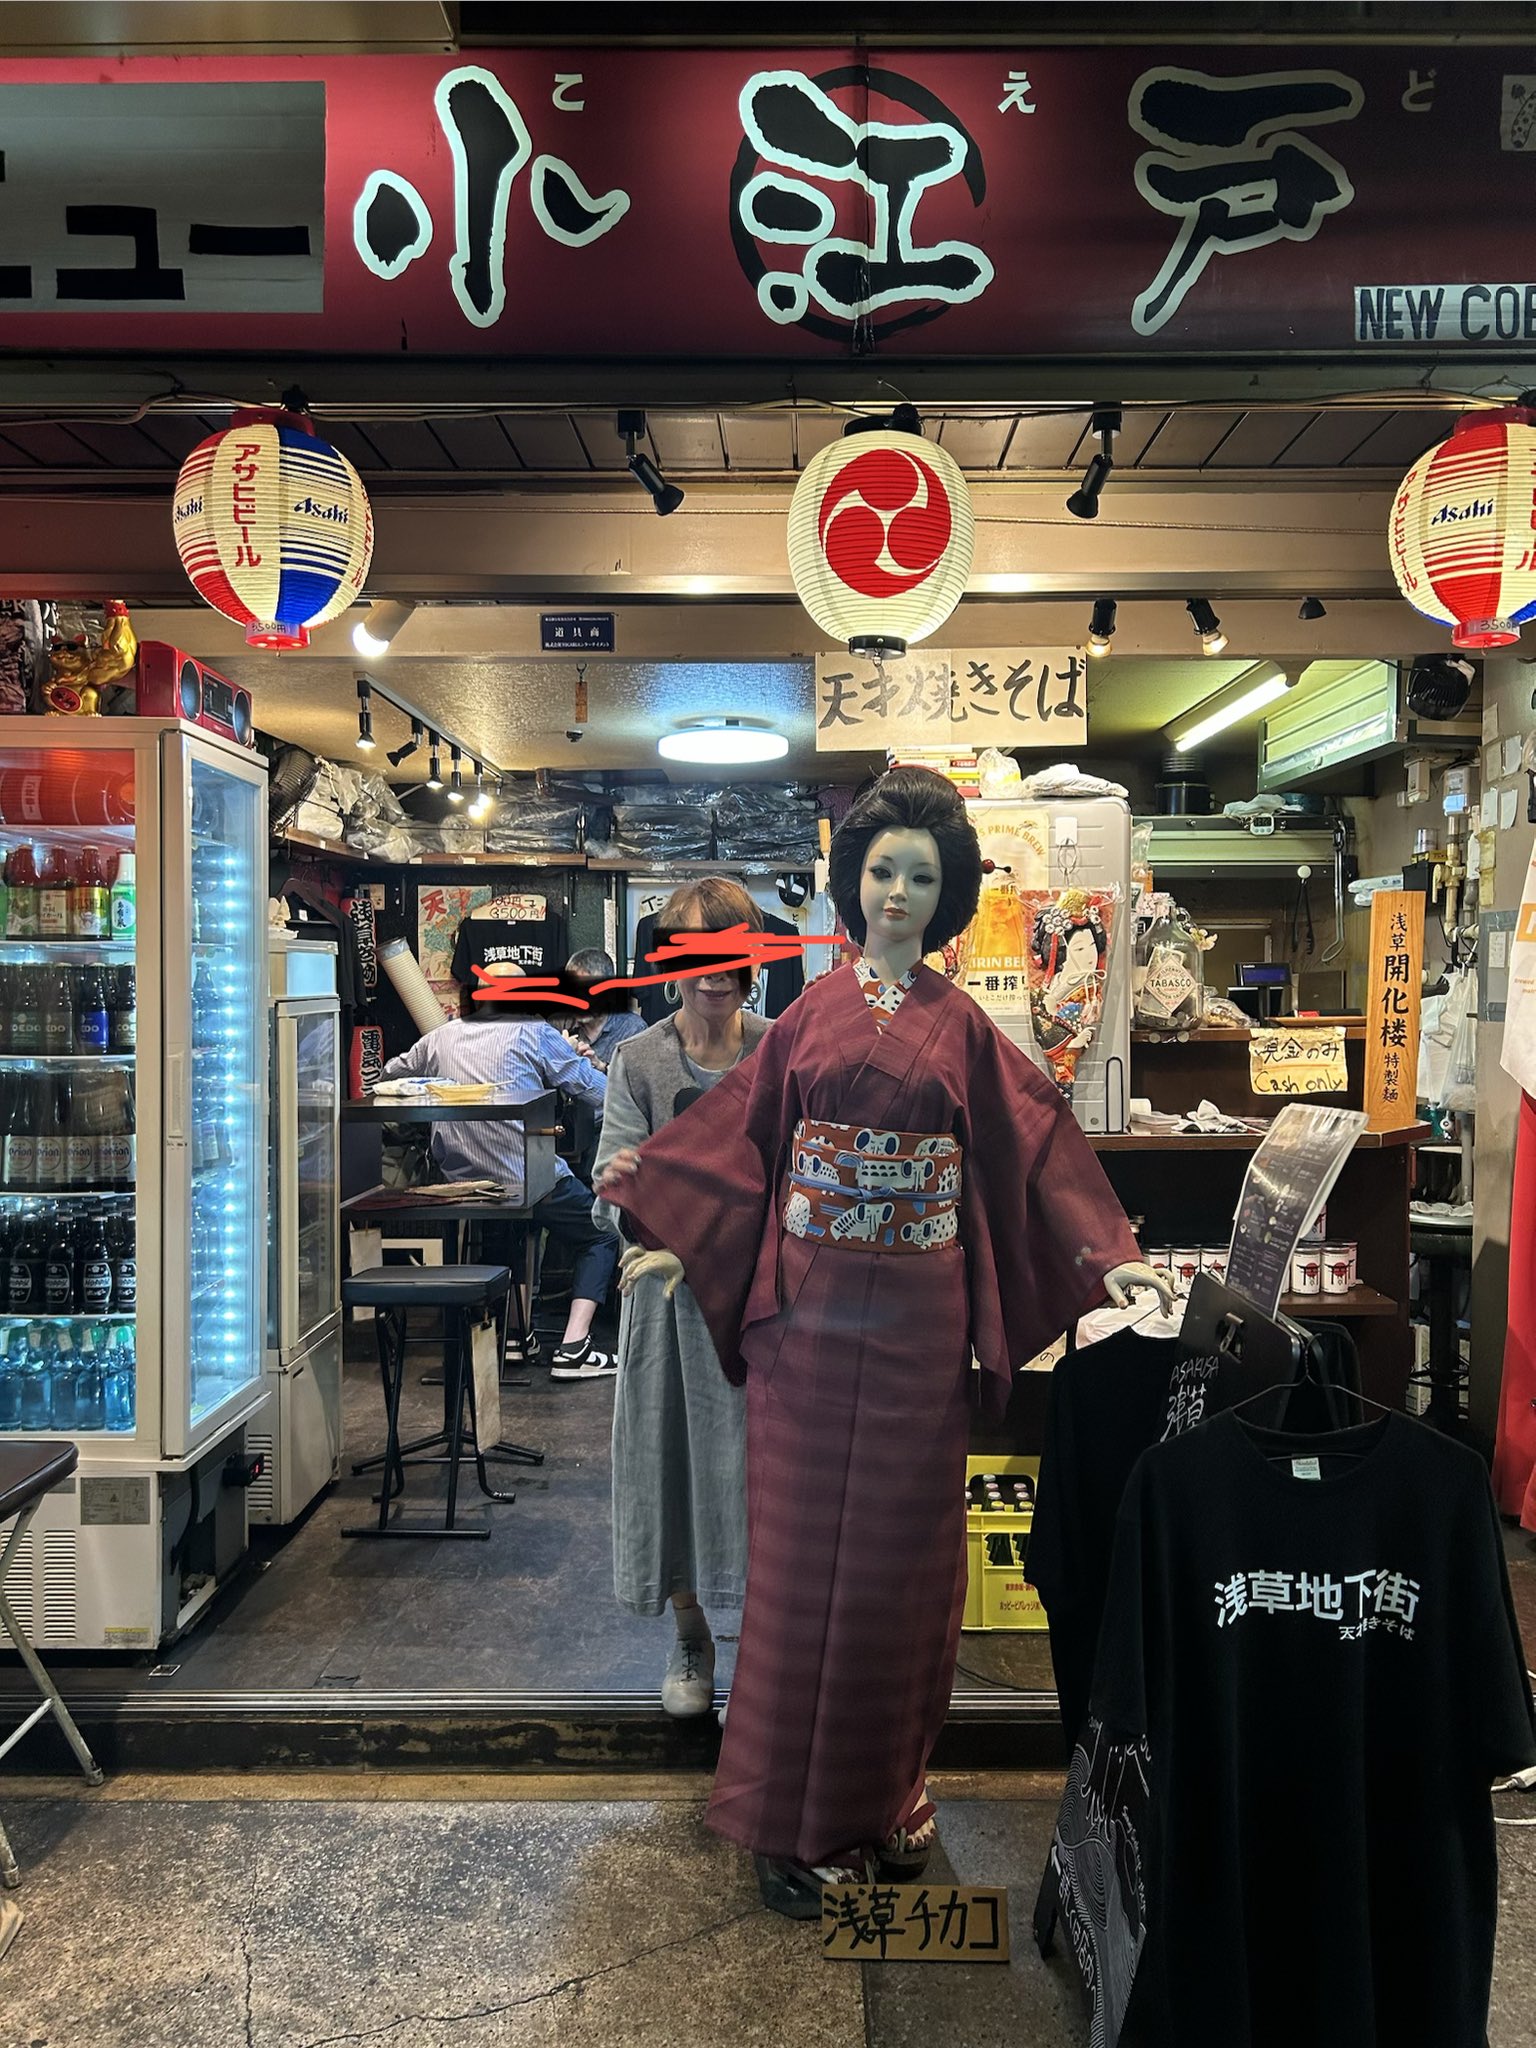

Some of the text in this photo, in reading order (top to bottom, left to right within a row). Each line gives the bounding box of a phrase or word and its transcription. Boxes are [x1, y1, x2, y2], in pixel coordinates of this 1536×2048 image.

[552, 68, 1437, 114] こ え ど
[0, 151, 311, 300] ュー
[1359, 287, 1445, 340] NEW
[232, 444, 262, 567] アサヒビール
[294, 497, 349, 524] Asahi
[1431, 498, 1494, 525] Asahi
[818, 655, 1086, 730] 天才焼きそば
[988, 824, 1021, 838] PRIME
[1021, 831, 1046, 857] BREW
[483, 945, 544, 962] 浅草地下街
[969, 956, 1001, 968] IRIN
[1150, 978, 1192, 988] TABASCO
[1255, 1037, 1340, 1064] 現金のみ
[1254, 1069, 1344, 1093] Cash only
[1214, 1568, 1421, 1628] 浅草地下街
[823, 1885, 999, 1960] 浅草チカコ
